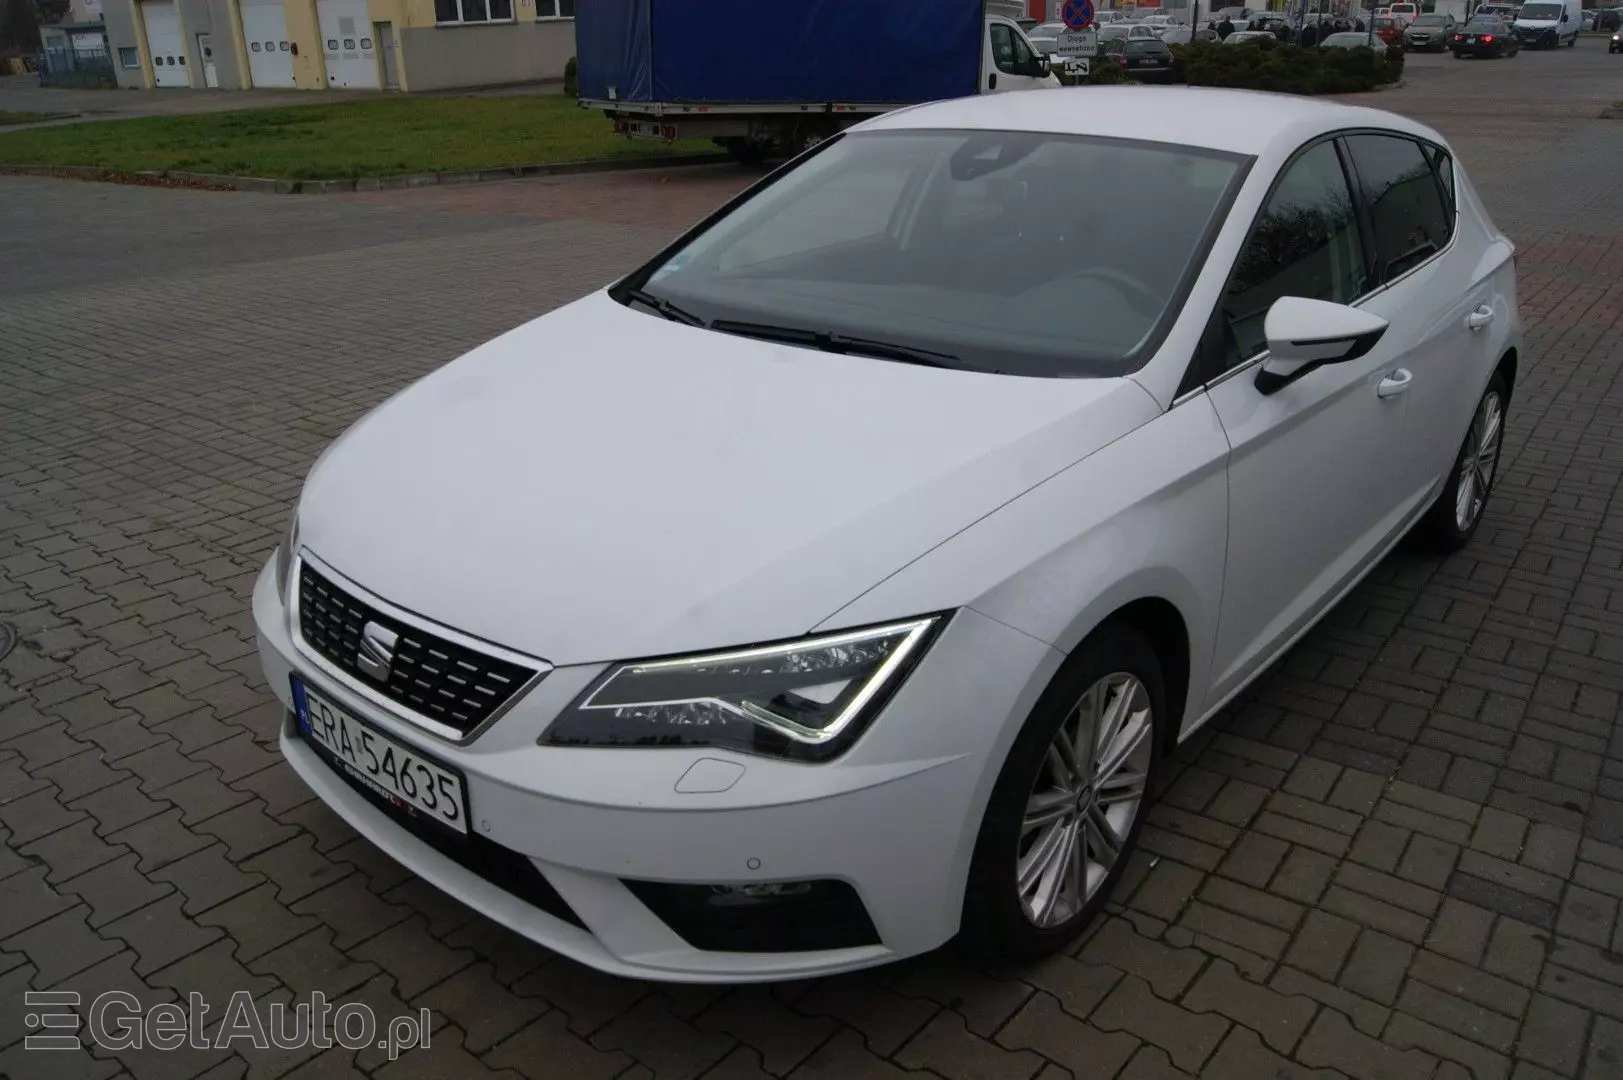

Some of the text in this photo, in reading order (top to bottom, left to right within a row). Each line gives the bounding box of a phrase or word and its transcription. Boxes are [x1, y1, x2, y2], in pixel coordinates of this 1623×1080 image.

[1067, 35, 1087, 43] Droga
[305, 692, 357, 763] ERA
[360, 729, 459, 821] 54635
